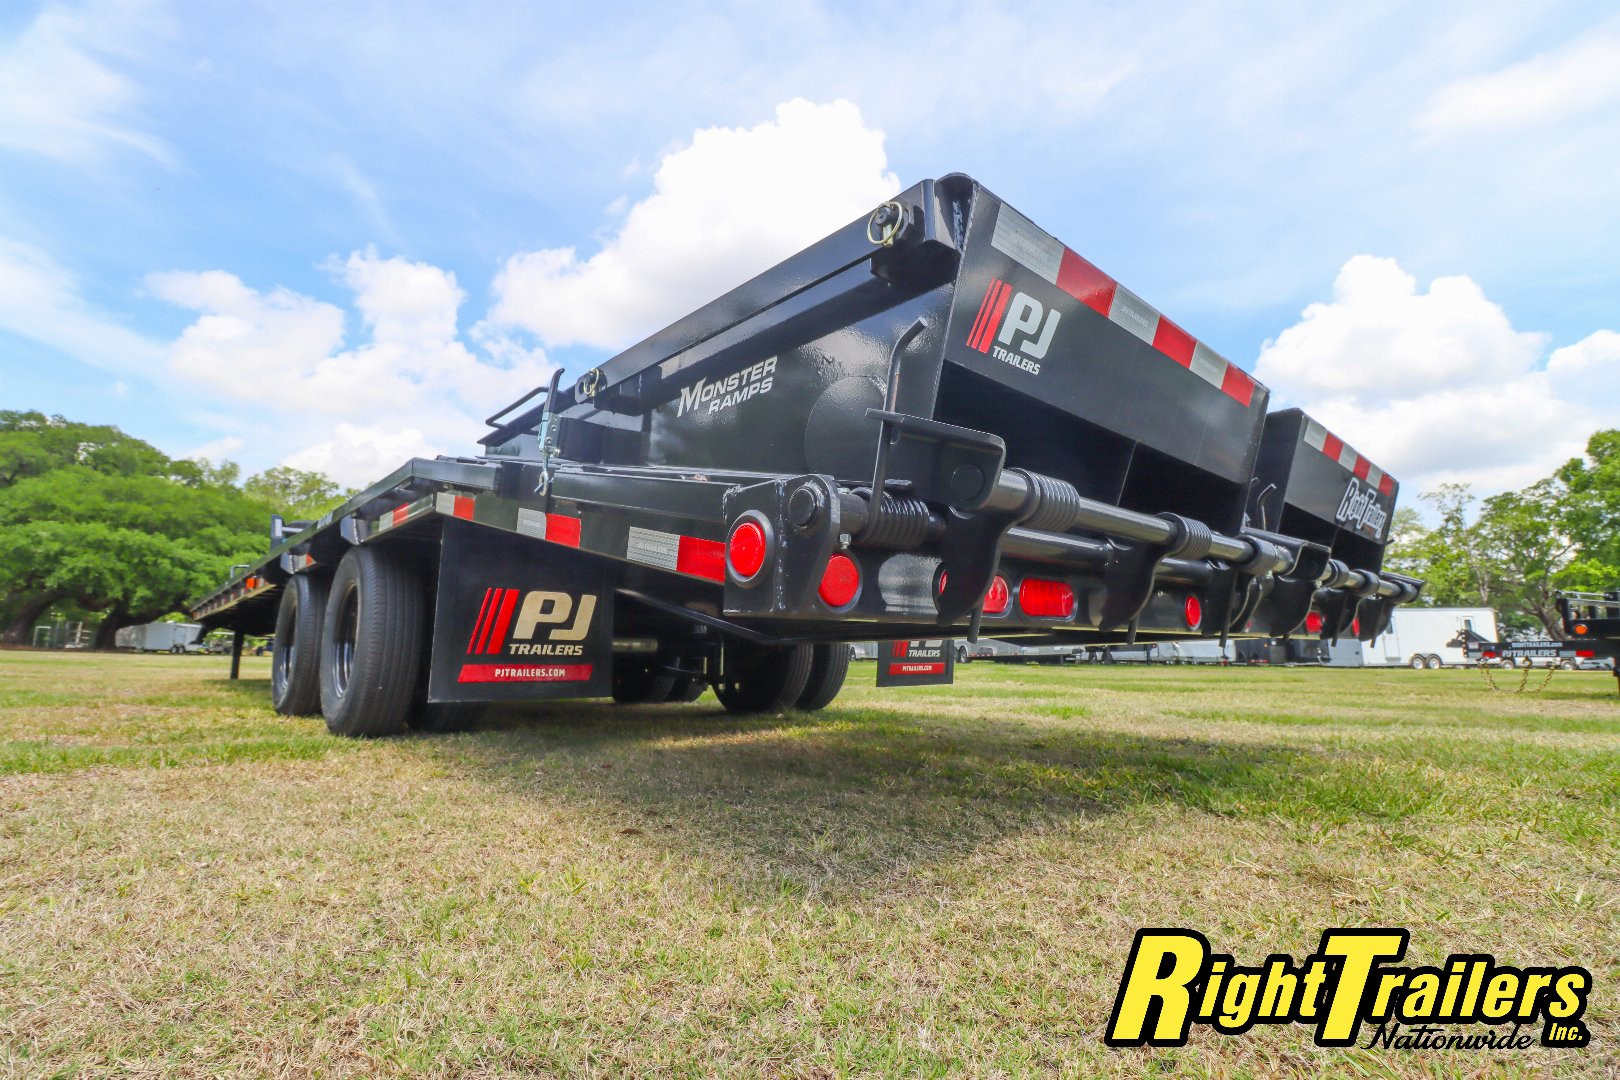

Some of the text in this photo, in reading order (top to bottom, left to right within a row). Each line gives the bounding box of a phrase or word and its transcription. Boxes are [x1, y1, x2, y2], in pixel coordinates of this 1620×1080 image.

[998, 291, 1061, 359] PJ
[992, 345, 1041, 376] TRAILERS
[676, 355, 778, 418] MONSTER
[708, 376, 774, 415] RAMPS
[512, 590, 597, 641] PJ
[509, 643, 584, 656] TRAILERS
[908, 649, 941, 658] TRAILERS
[494, 668, 566, 677] PJTRAILERS.COM
